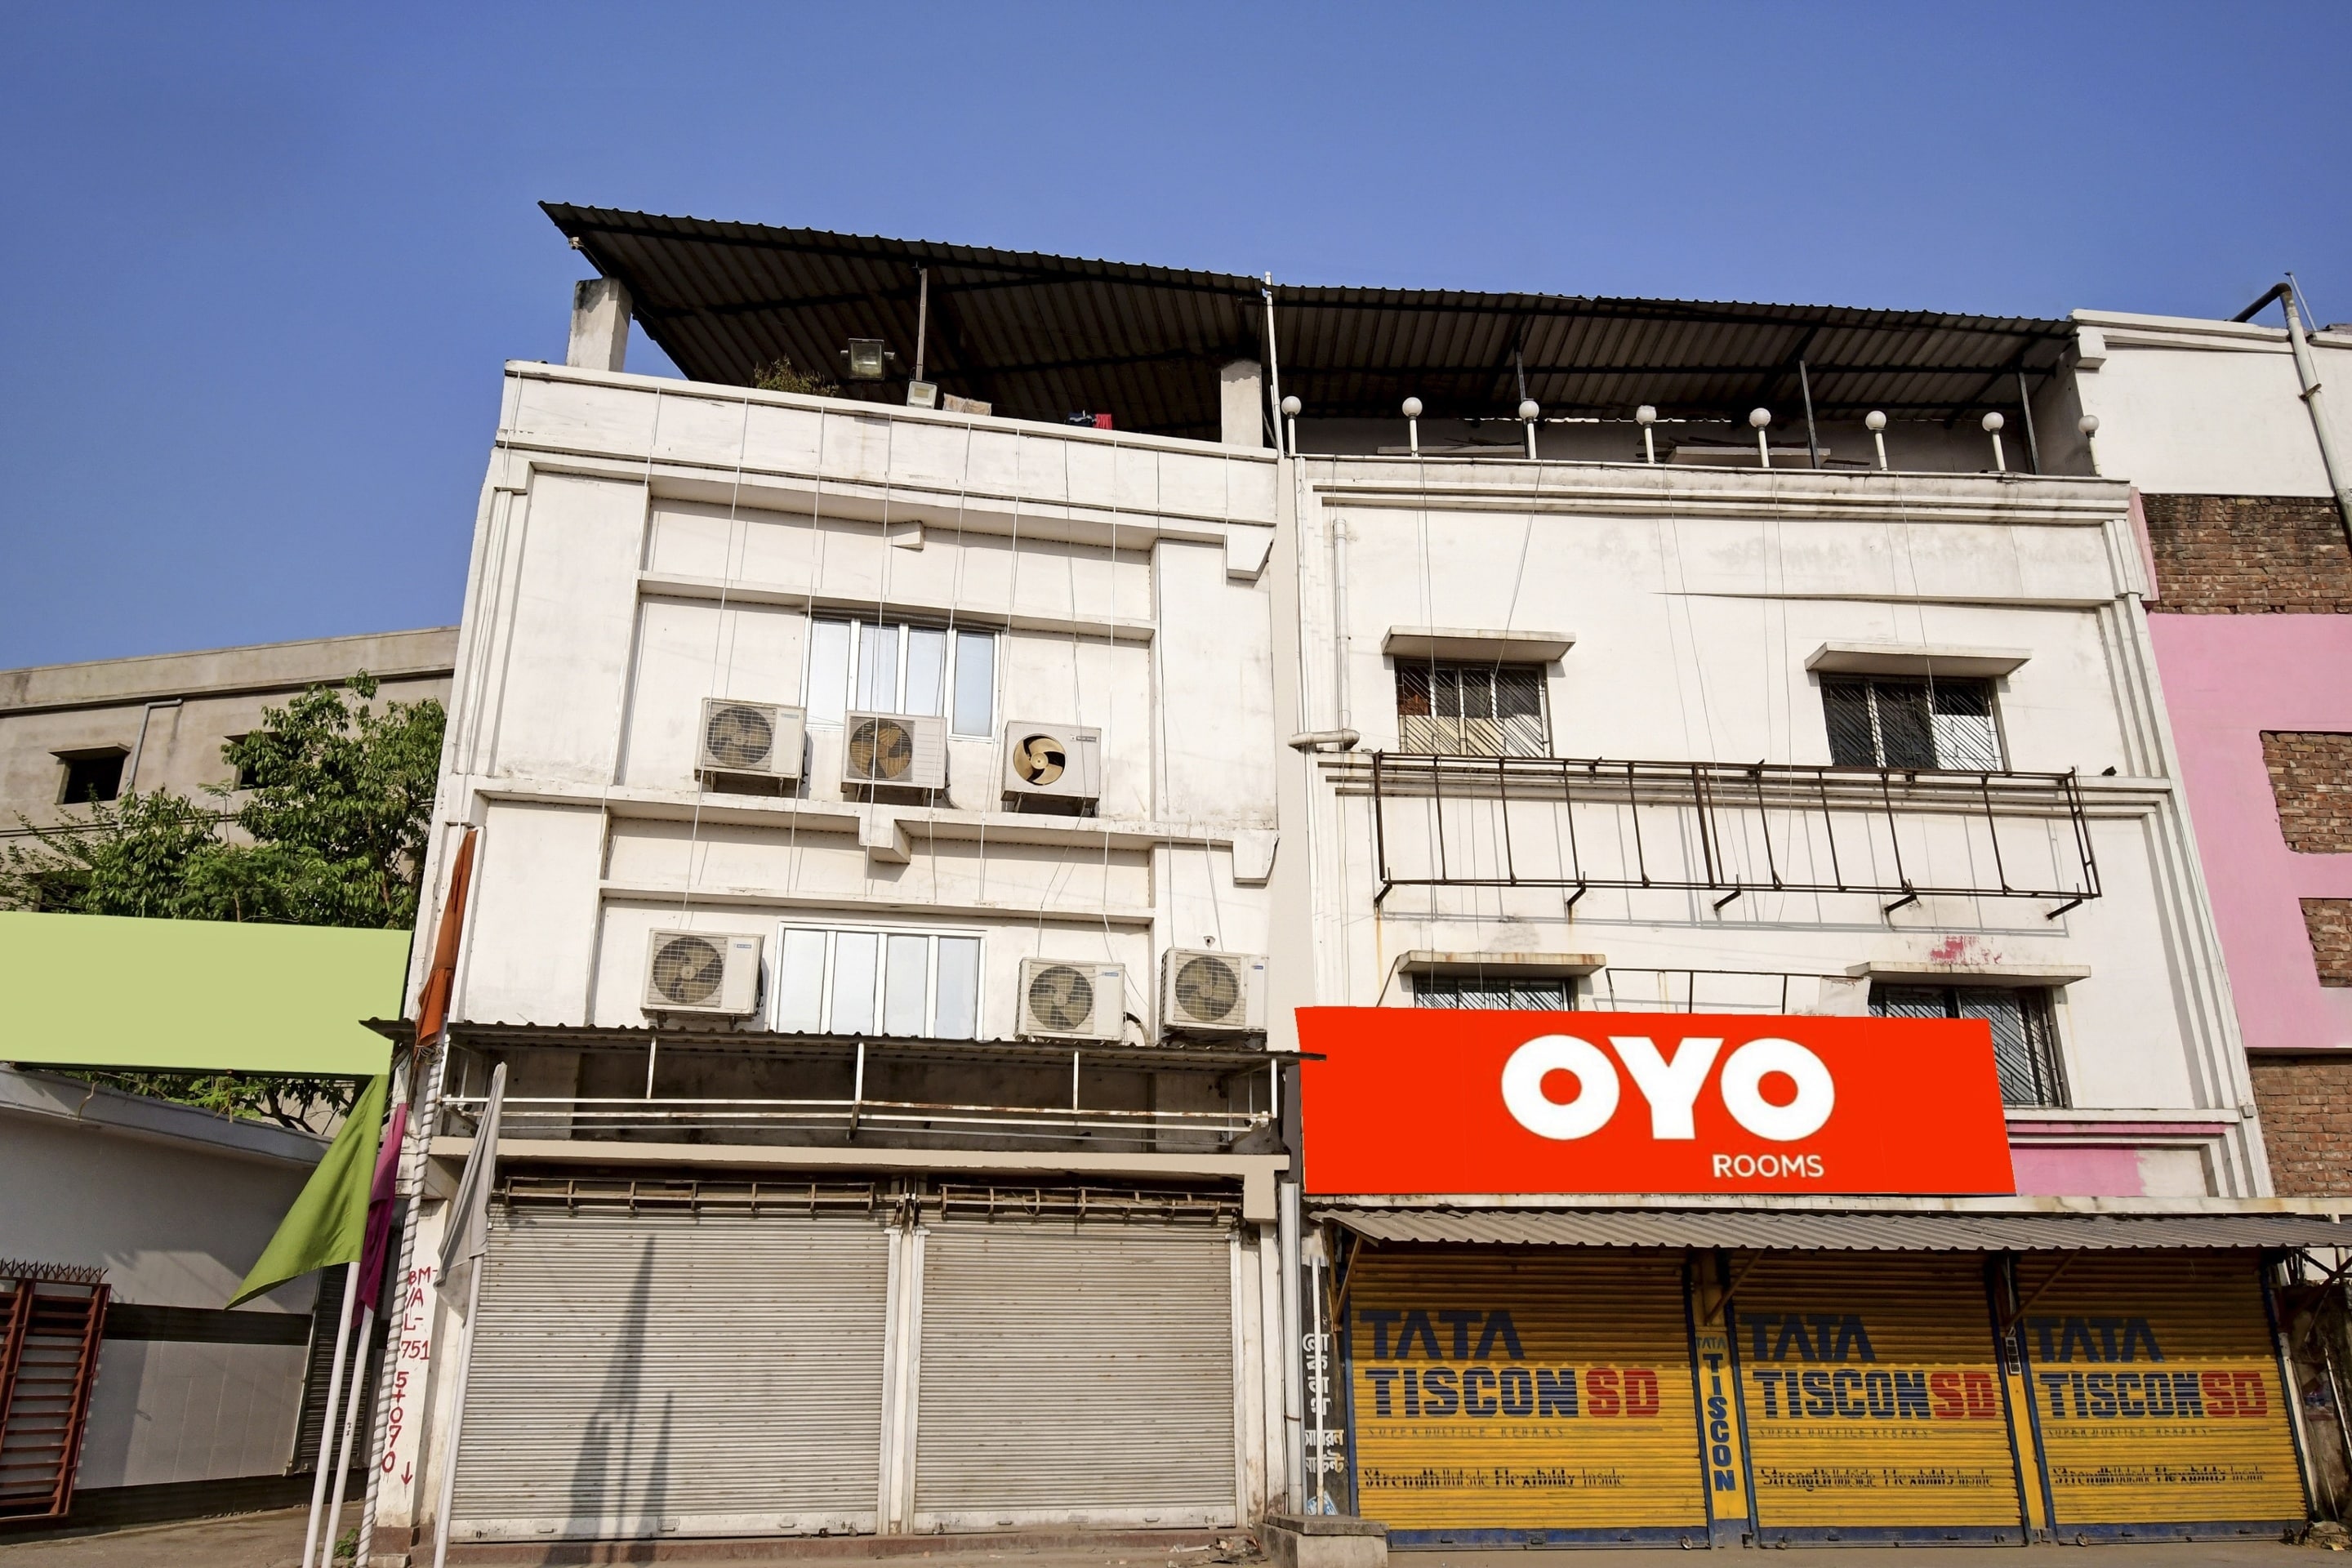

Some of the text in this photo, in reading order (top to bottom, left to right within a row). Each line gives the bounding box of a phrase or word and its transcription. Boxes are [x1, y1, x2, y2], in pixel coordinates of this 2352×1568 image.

[1501, 1034, 1835, 1142] OYO
[1712, 1154, 1825, 1179] ROOMS
[400, 1339, 430, 1361] 751
[1359, 1310, 1526, 1360] TATA
[1740, 1313, 1877, 1362] TATA
[2027, 1316, 2165, 1362] TATA
[1365, 1367, 1659, 1418] TISCON SD
[1753, 1369, 1997, 1419] TISCON SD
[2039, 1372, 2268, 1419] TISCON SD
[1703, 1353, 1736, 1490] TISCON
